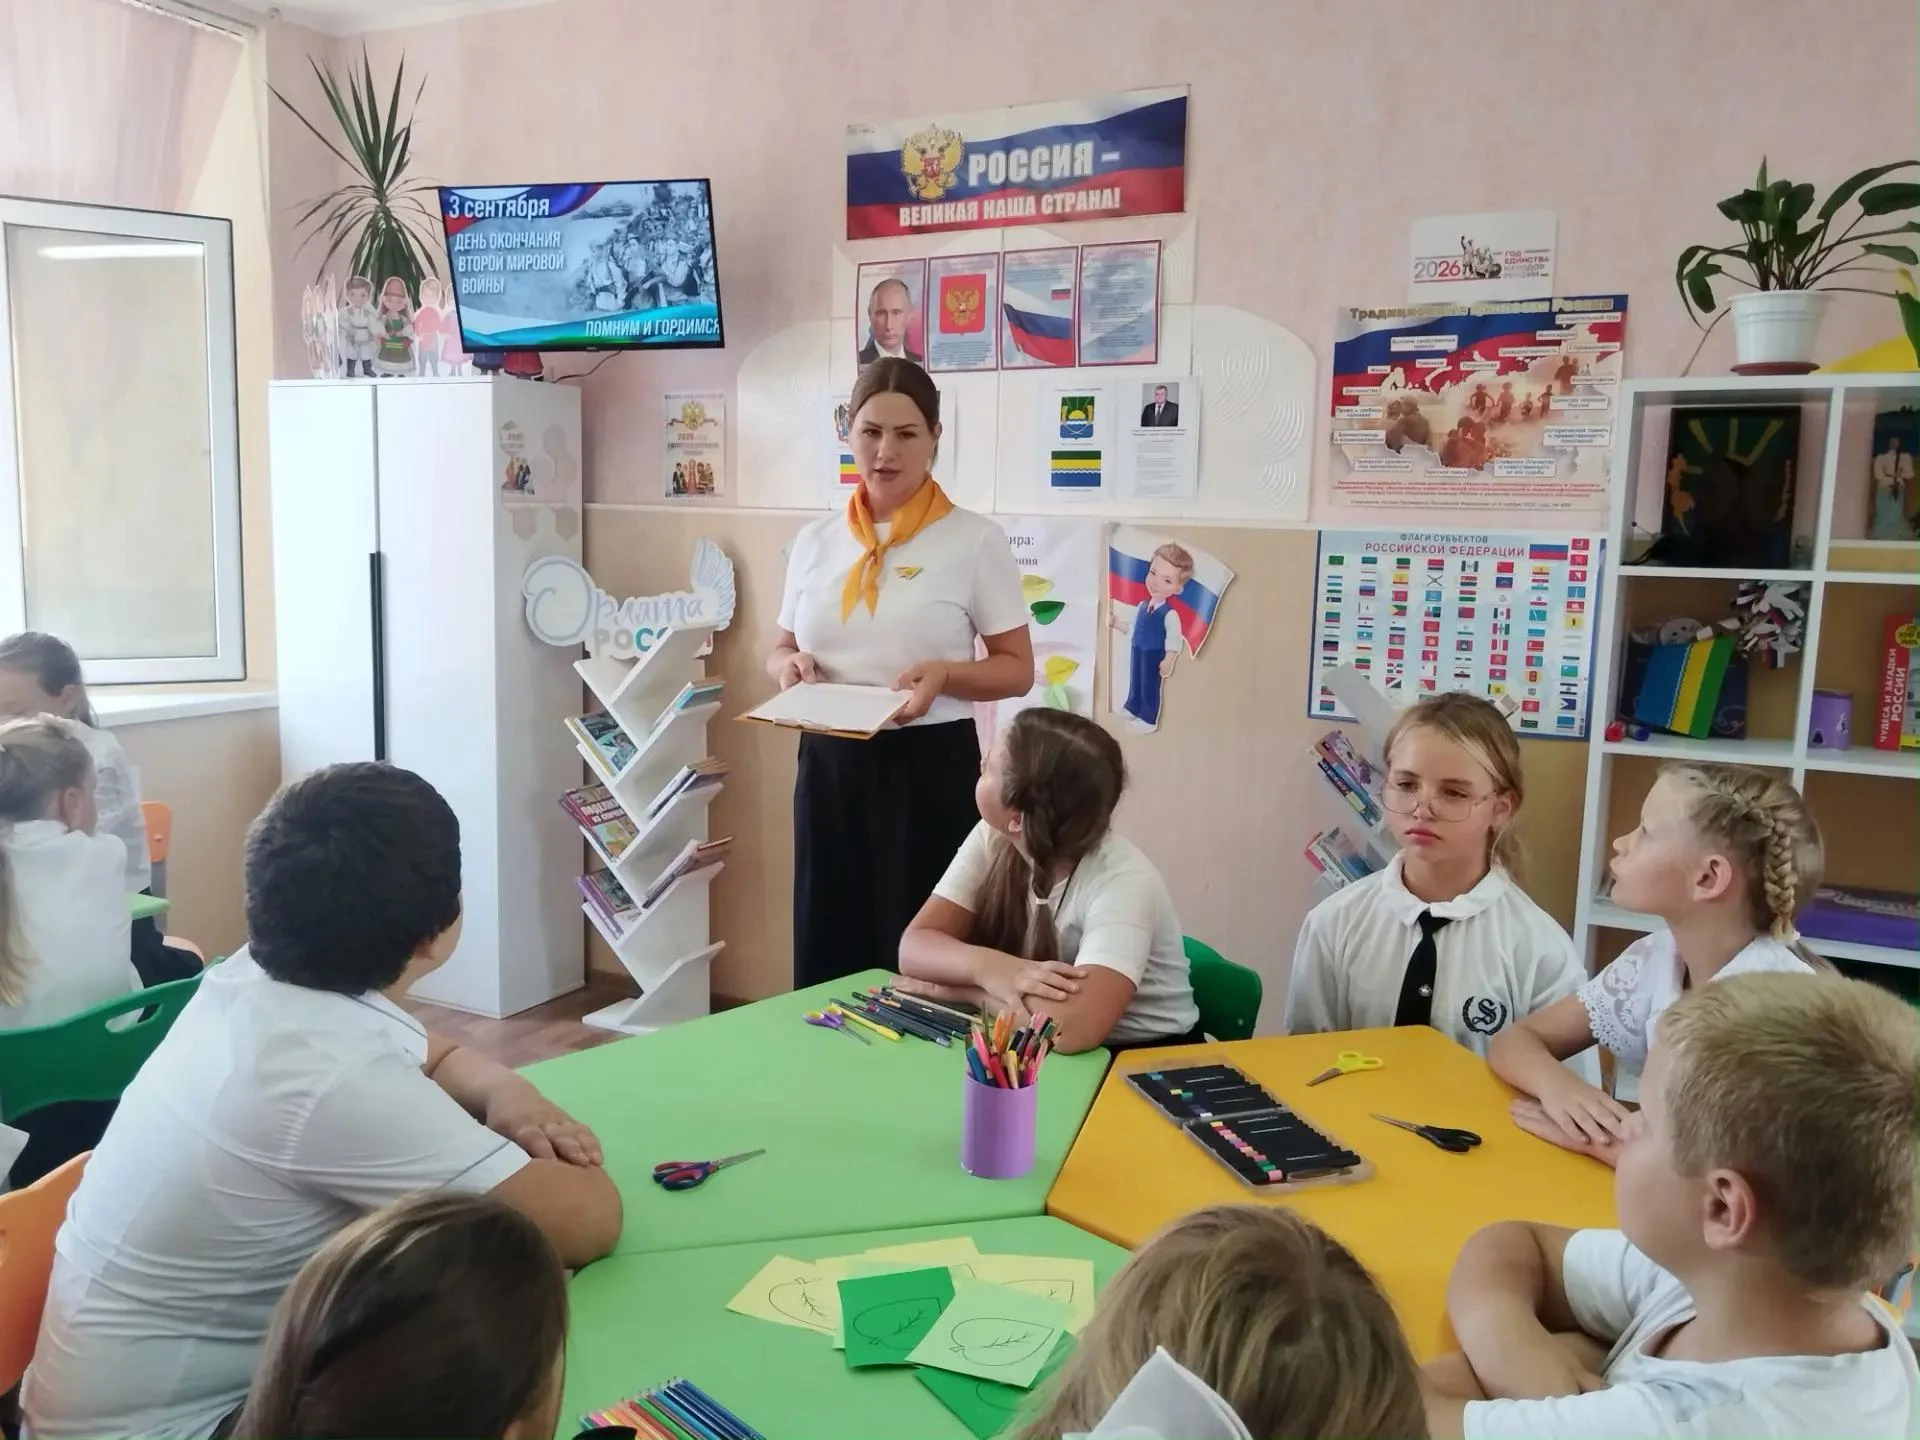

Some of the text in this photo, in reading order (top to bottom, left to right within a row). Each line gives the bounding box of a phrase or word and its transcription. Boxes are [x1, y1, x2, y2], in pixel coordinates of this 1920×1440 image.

[969, 141, 1094, 186] РОССИЯ
[449, 195, 550, 220] 3 сентября
[899, 187, 1121, 227] ВЕЛИКАЯ НАША СТРАНА!
[455, 232, 561, 251] ДЕНЬ ОКОНЧАНИЯ
[458, 252, 565, 272] ВТОРОЙ МИРОВОЙ
[1414, 260, 1461, 279] 2026
[1505, 256, 1550, 264] ЕДИНСТВА
[462, 275, 504, 294] ВОЙНЫ
[586, 317, 720, 337] ПОМНИМ И ГОРДИМСЯ
[1009, 536, 1035, 549] ира:
[1400, 533, 1488, 544] ФЛАГИ СУБЪЕКТОВ
[1365, 542, 1525, 557] РОССИЙСКОЙ ФЕДЕРАЦИИ
[1880, 648, 1896, 742] ЧУДЕСА И ЗАГАДКИ
[1891, 667, 1906, 721] РОССИИ
